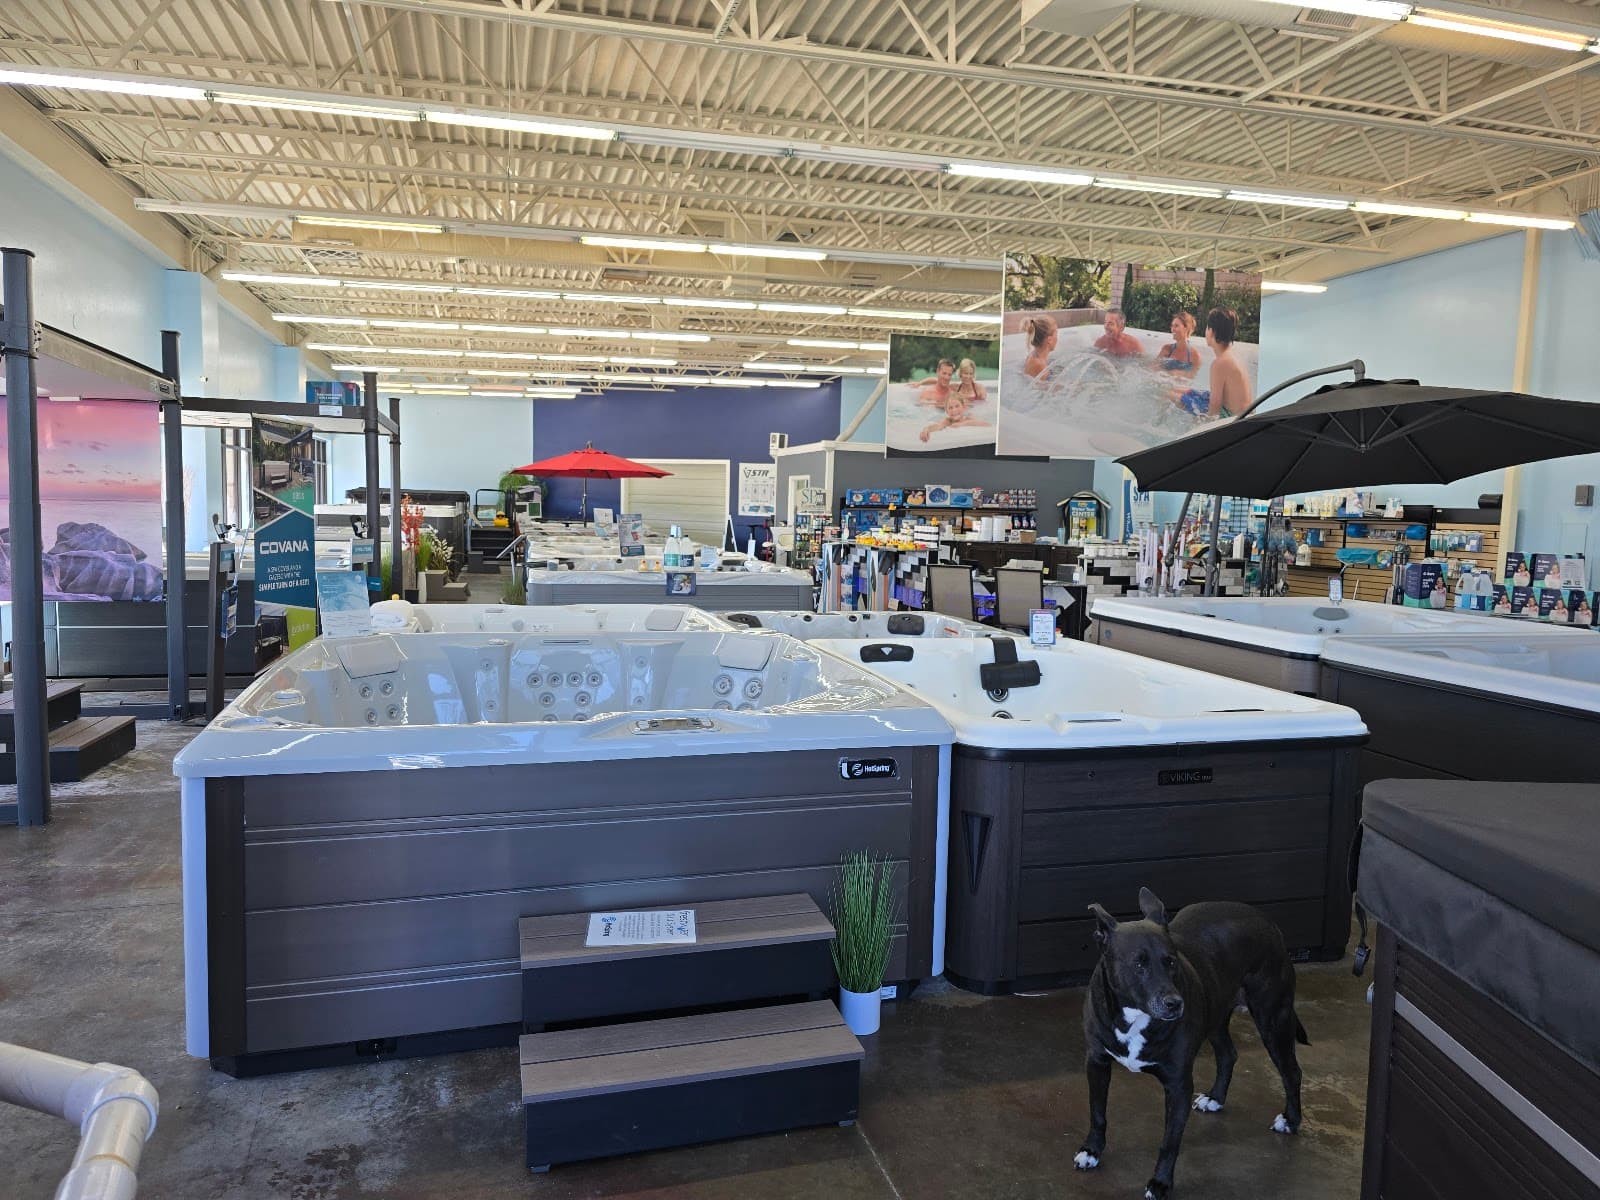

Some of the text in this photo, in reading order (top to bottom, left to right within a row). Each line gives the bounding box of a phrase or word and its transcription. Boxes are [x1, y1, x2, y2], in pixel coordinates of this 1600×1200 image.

[751, 469, 769, 477] STR
[1133, 486, 1150, 502] SPA
[259, 540, 309, 555] COVANA
[1170, 771, 1201, 782] VIKING
